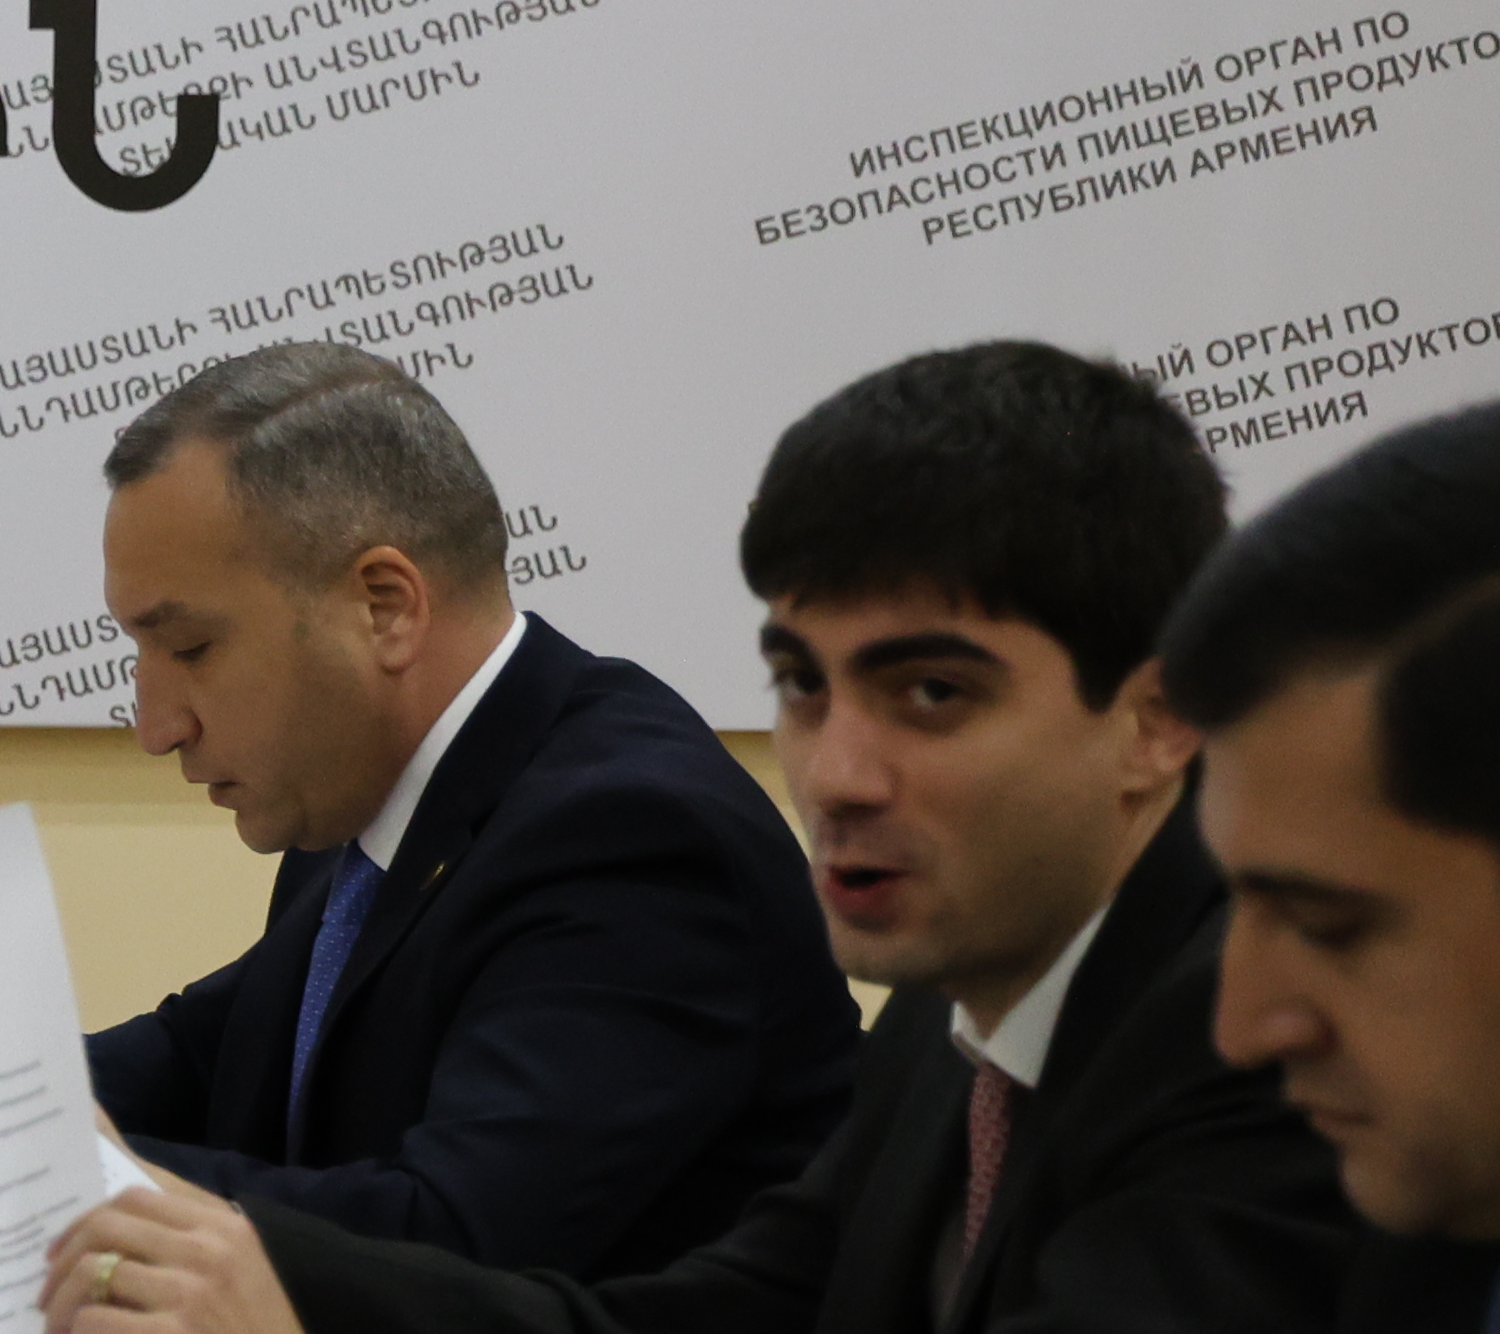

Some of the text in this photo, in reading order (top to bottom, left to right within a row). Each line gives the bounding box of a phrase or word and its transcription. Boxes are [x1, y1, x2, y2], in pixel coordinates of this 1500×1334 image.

[755, 142, 1066, 245] БЕЗОПАСНОСТИ
[1077, 86, 1284, 162] ПИЩЕВЫХ
[850, 11, 1409, 178] ИНСПЕКЦИОННЫЙ ОРГАН ПО
[922, 105, 1377, 245] РЕСПУБЛИКИ АРМЕНИЯ
